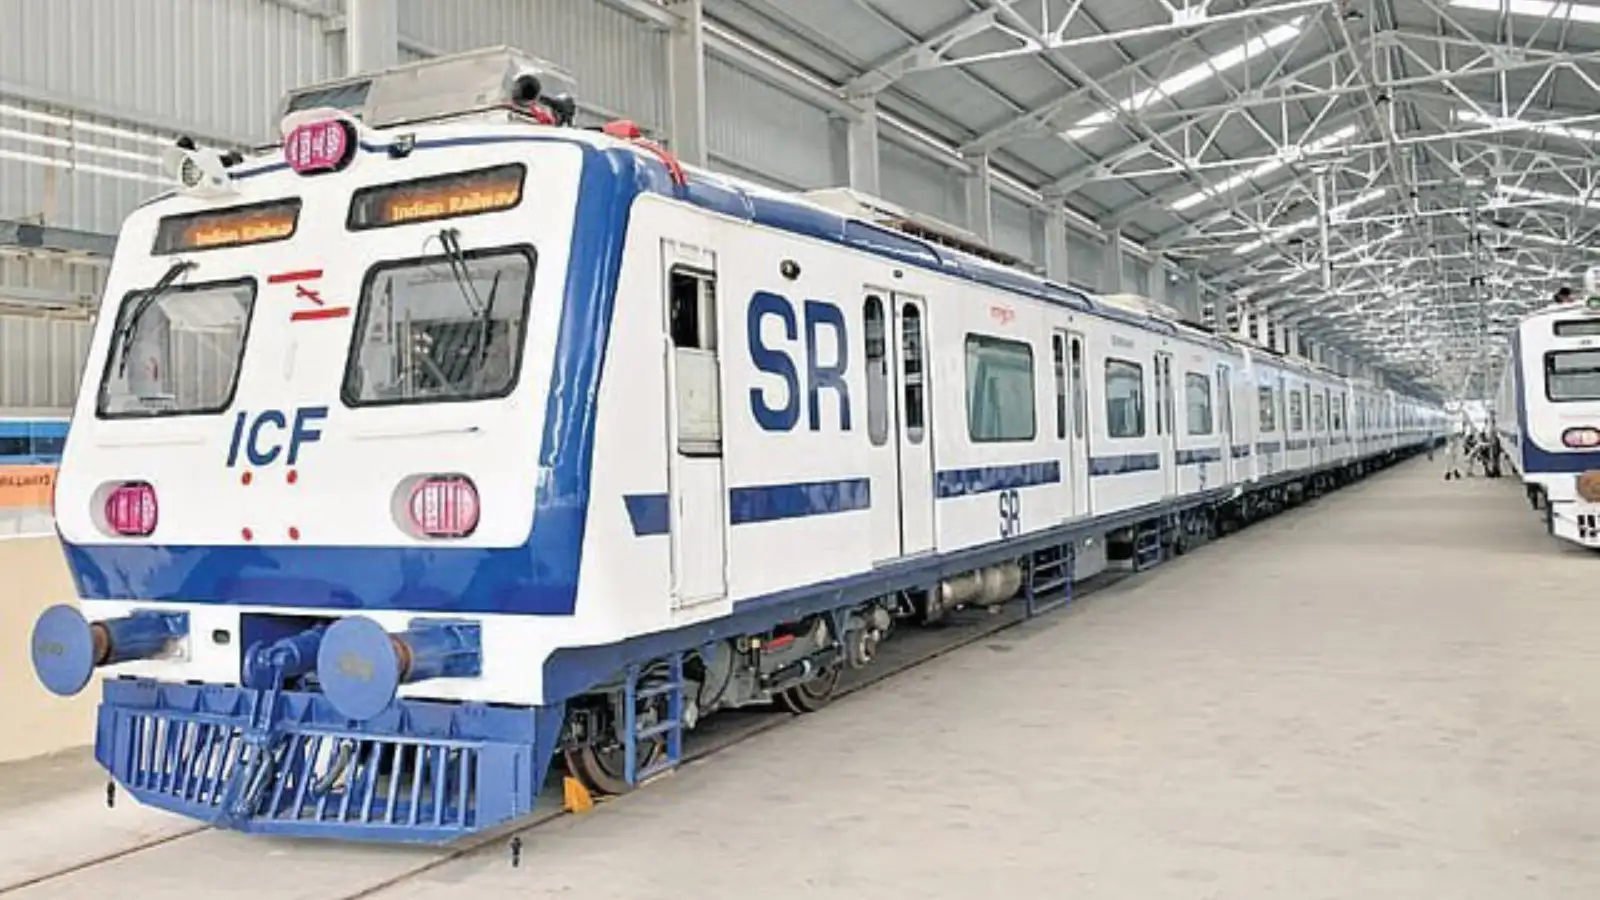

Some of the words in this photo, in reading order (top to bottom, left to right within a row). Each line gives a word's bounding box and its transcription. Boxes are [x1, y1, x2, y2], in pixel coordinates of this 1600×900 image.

[393, 200, 444, 222] Indian
[747, 290, 852, 431] SR
[227, 406, 328, 467] ICF
[1000, 489, 1020, 536] SR
